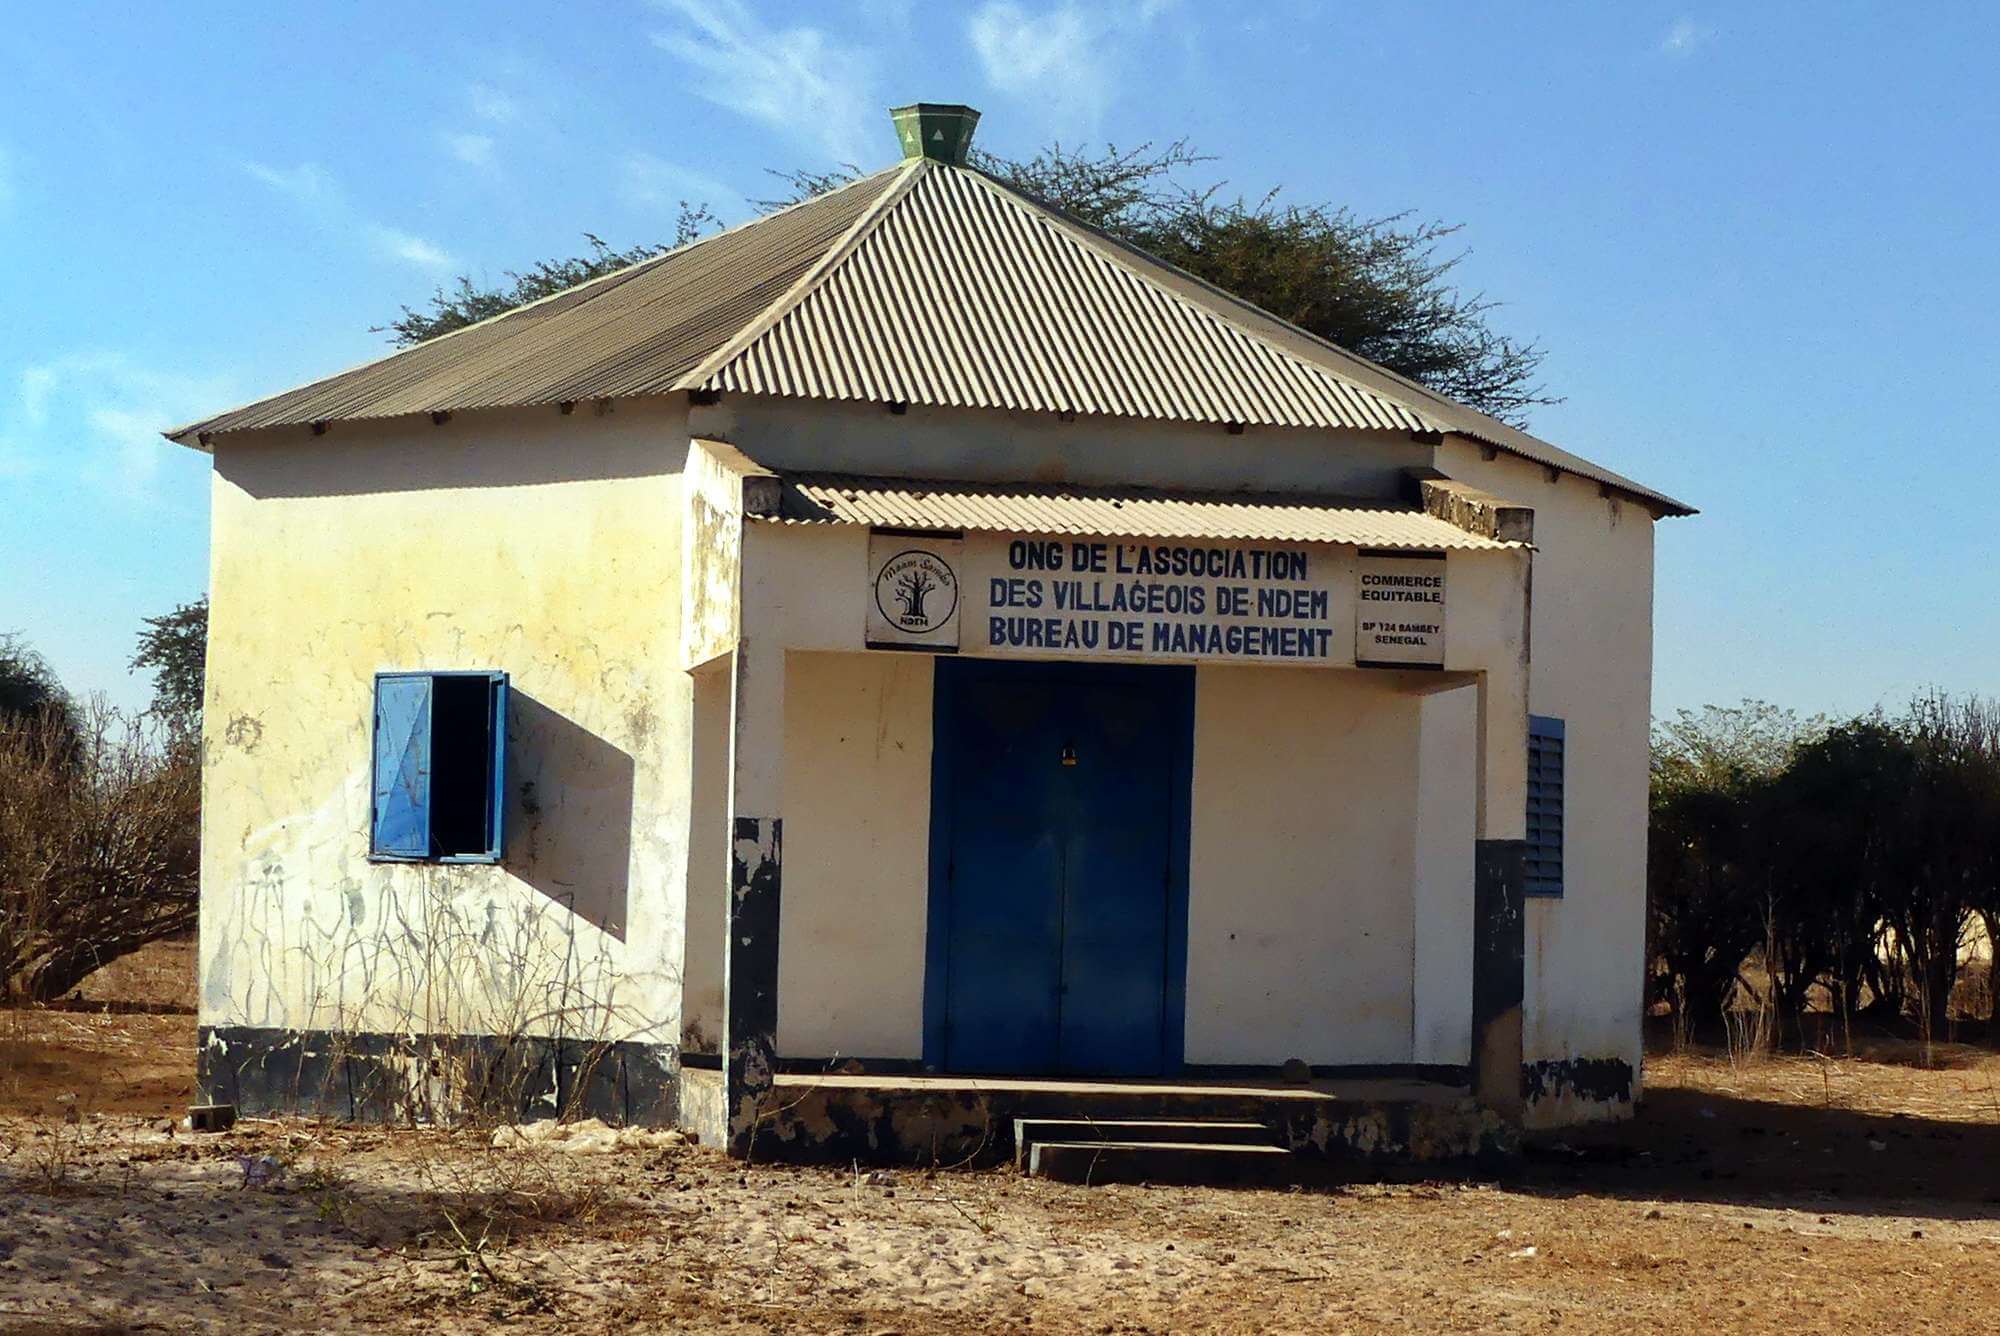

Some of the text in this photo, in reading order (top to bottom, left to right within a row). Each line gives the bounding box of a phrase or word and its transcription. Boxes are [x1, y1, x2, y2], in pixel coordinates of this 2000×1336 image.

[1008, 540, 1307, 581] ONG DE L'ASSOCIATION
[1361, 575, 1442, 588] COMMERCE
[990, 578, 1328, 620] DES VILLAGEOIS DE NDEM
[1361, 590, 1441, 603] EQUITABLE
[1379, 622, 1396, 632] 124
[1398, 623, 1440, 634] BAMBEY
[989, 617, 1333, 657] BUREAU DE MANAGEMENT
[1375, 635, 1427, 646] SENEGAL
